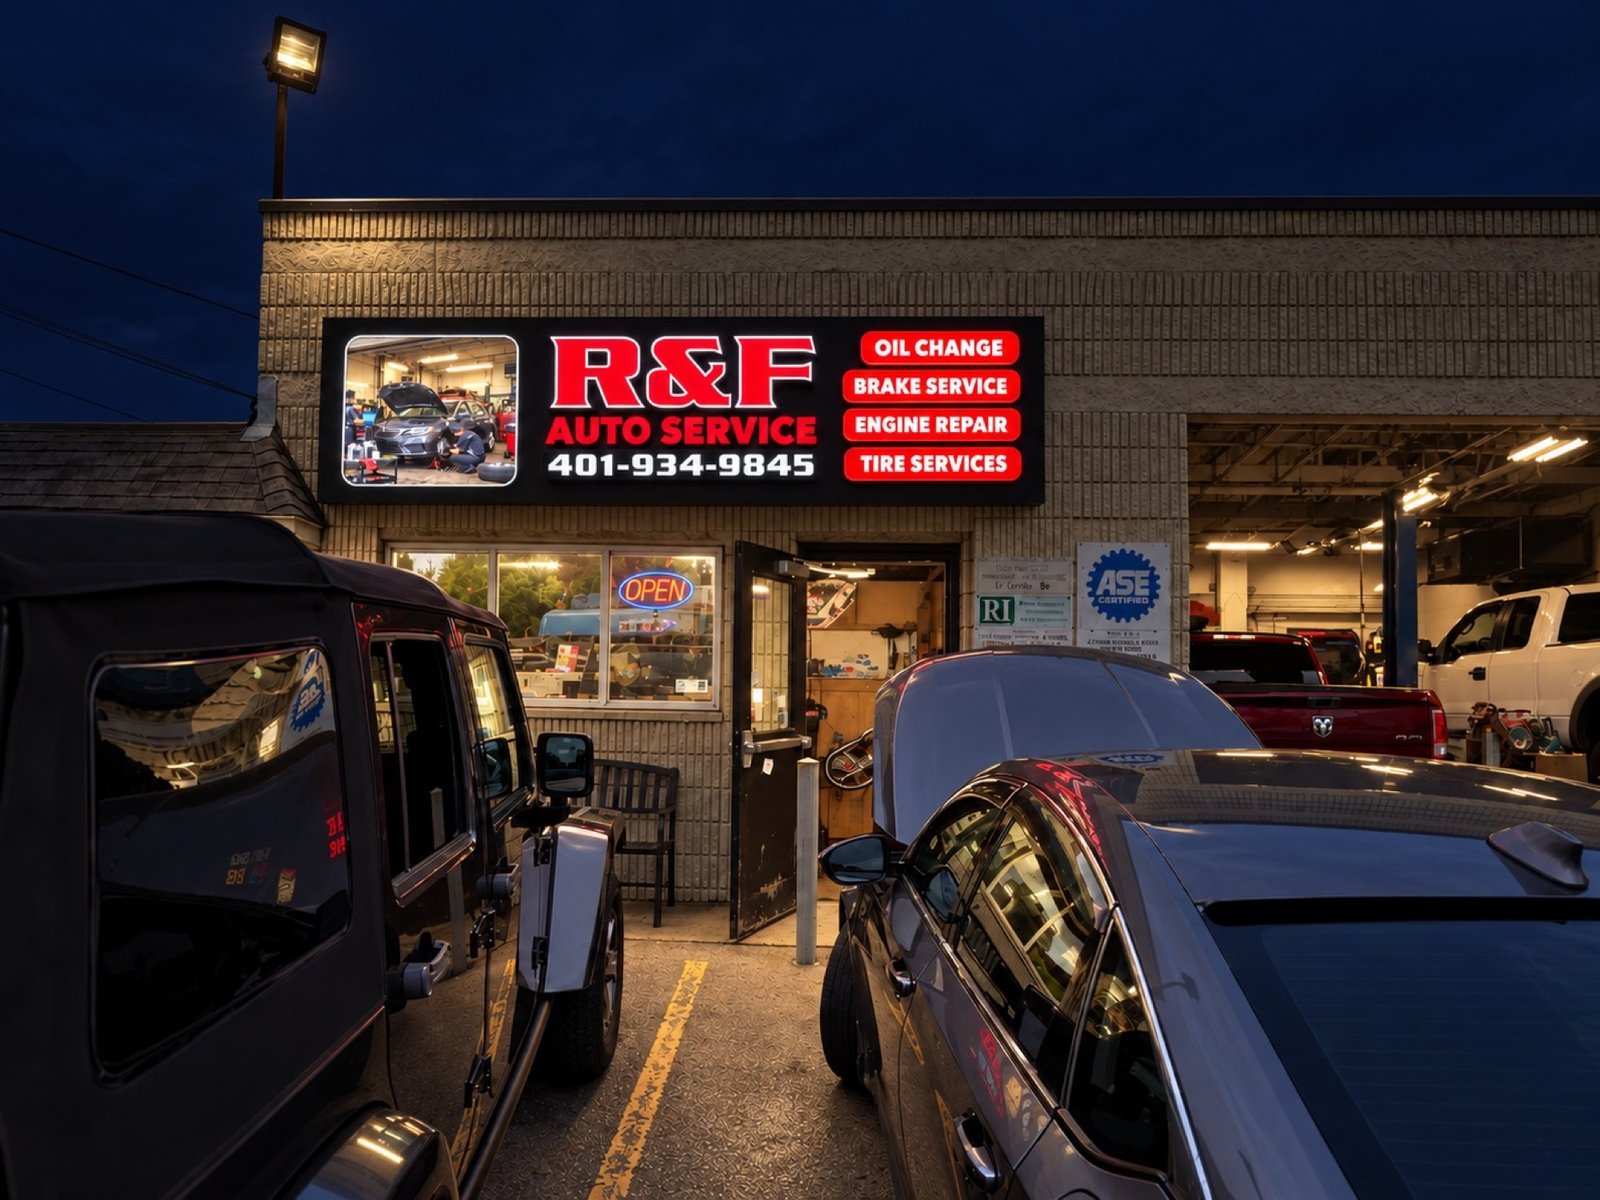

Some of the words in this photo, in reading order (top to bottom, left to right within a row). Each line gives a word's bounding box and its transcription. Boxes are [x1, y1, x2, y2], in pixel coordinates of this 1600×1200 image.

[875, 339, 910, 356] OIL
[915, 339, 1003, 356] CHANGE
[550, 336, 816, 408] R&F
[854, 378, 921, 394] BRAKE
[926, 378, 1007, 394] SERVICE
[545, 416, 651, 445] AUTO
[660, 416, 817, 445] SERVICE
[855, 416, 930, 433] ENGINE
[935, 416, 1008, 433] REPAIR
[548, 453, 815, 477] 401-934-9845
[860, 455, 905, 472] TIRE
[910, 455, 1007, 472] SERVICES
[625, 579, 686, 602] OPEN
[1096, 570, 1150, 595] ASE
[983, 599, 1011, 621] RI
